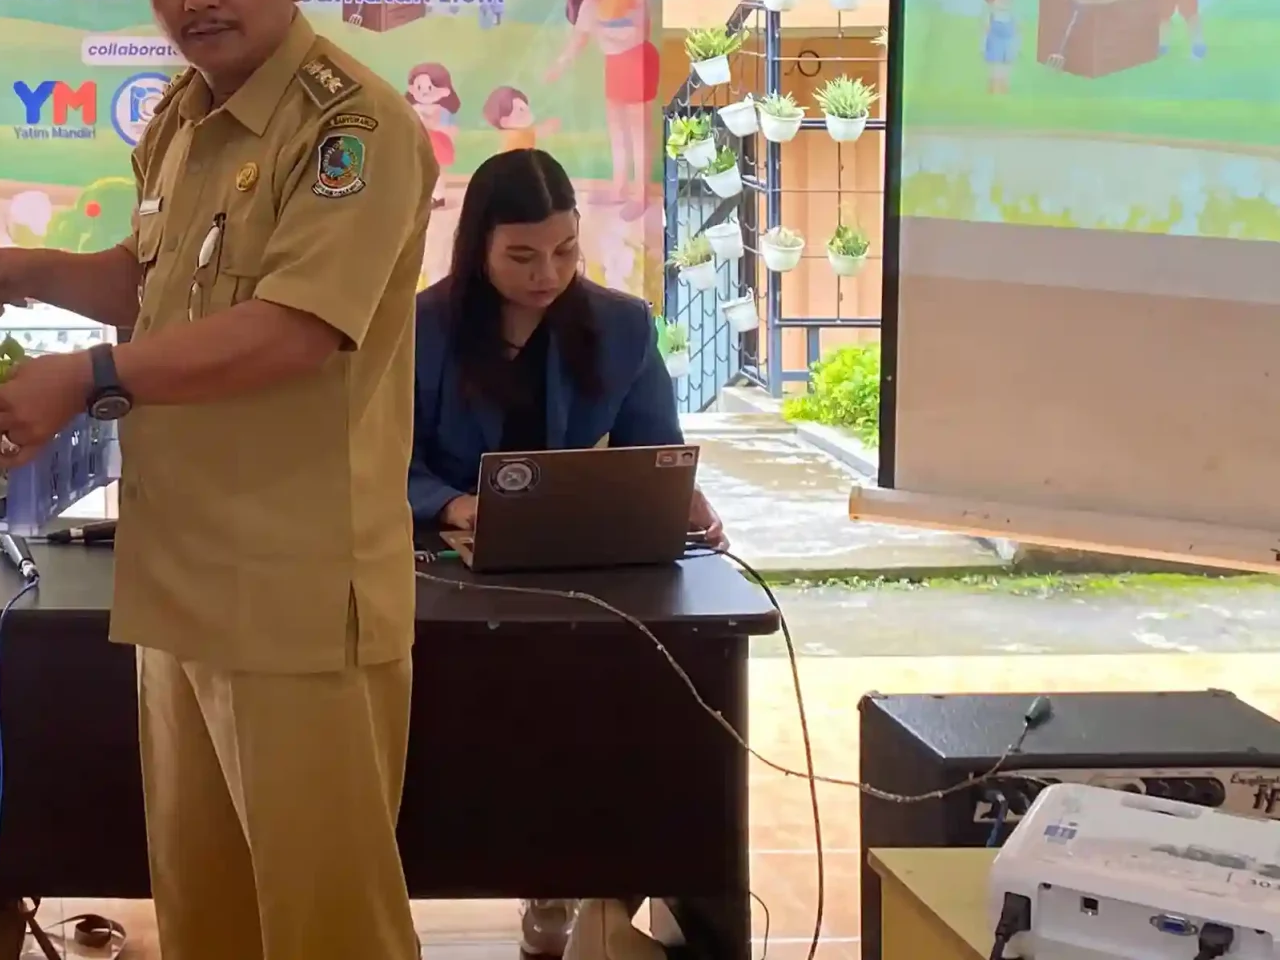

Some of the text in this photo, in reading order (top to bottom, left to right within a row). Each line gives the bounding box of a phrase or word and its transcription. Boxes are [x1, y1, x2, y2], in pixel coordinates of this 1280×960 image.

[13, 80, 97, 125] YM
[14, 126, 97, 139] Yatim Mandiri
